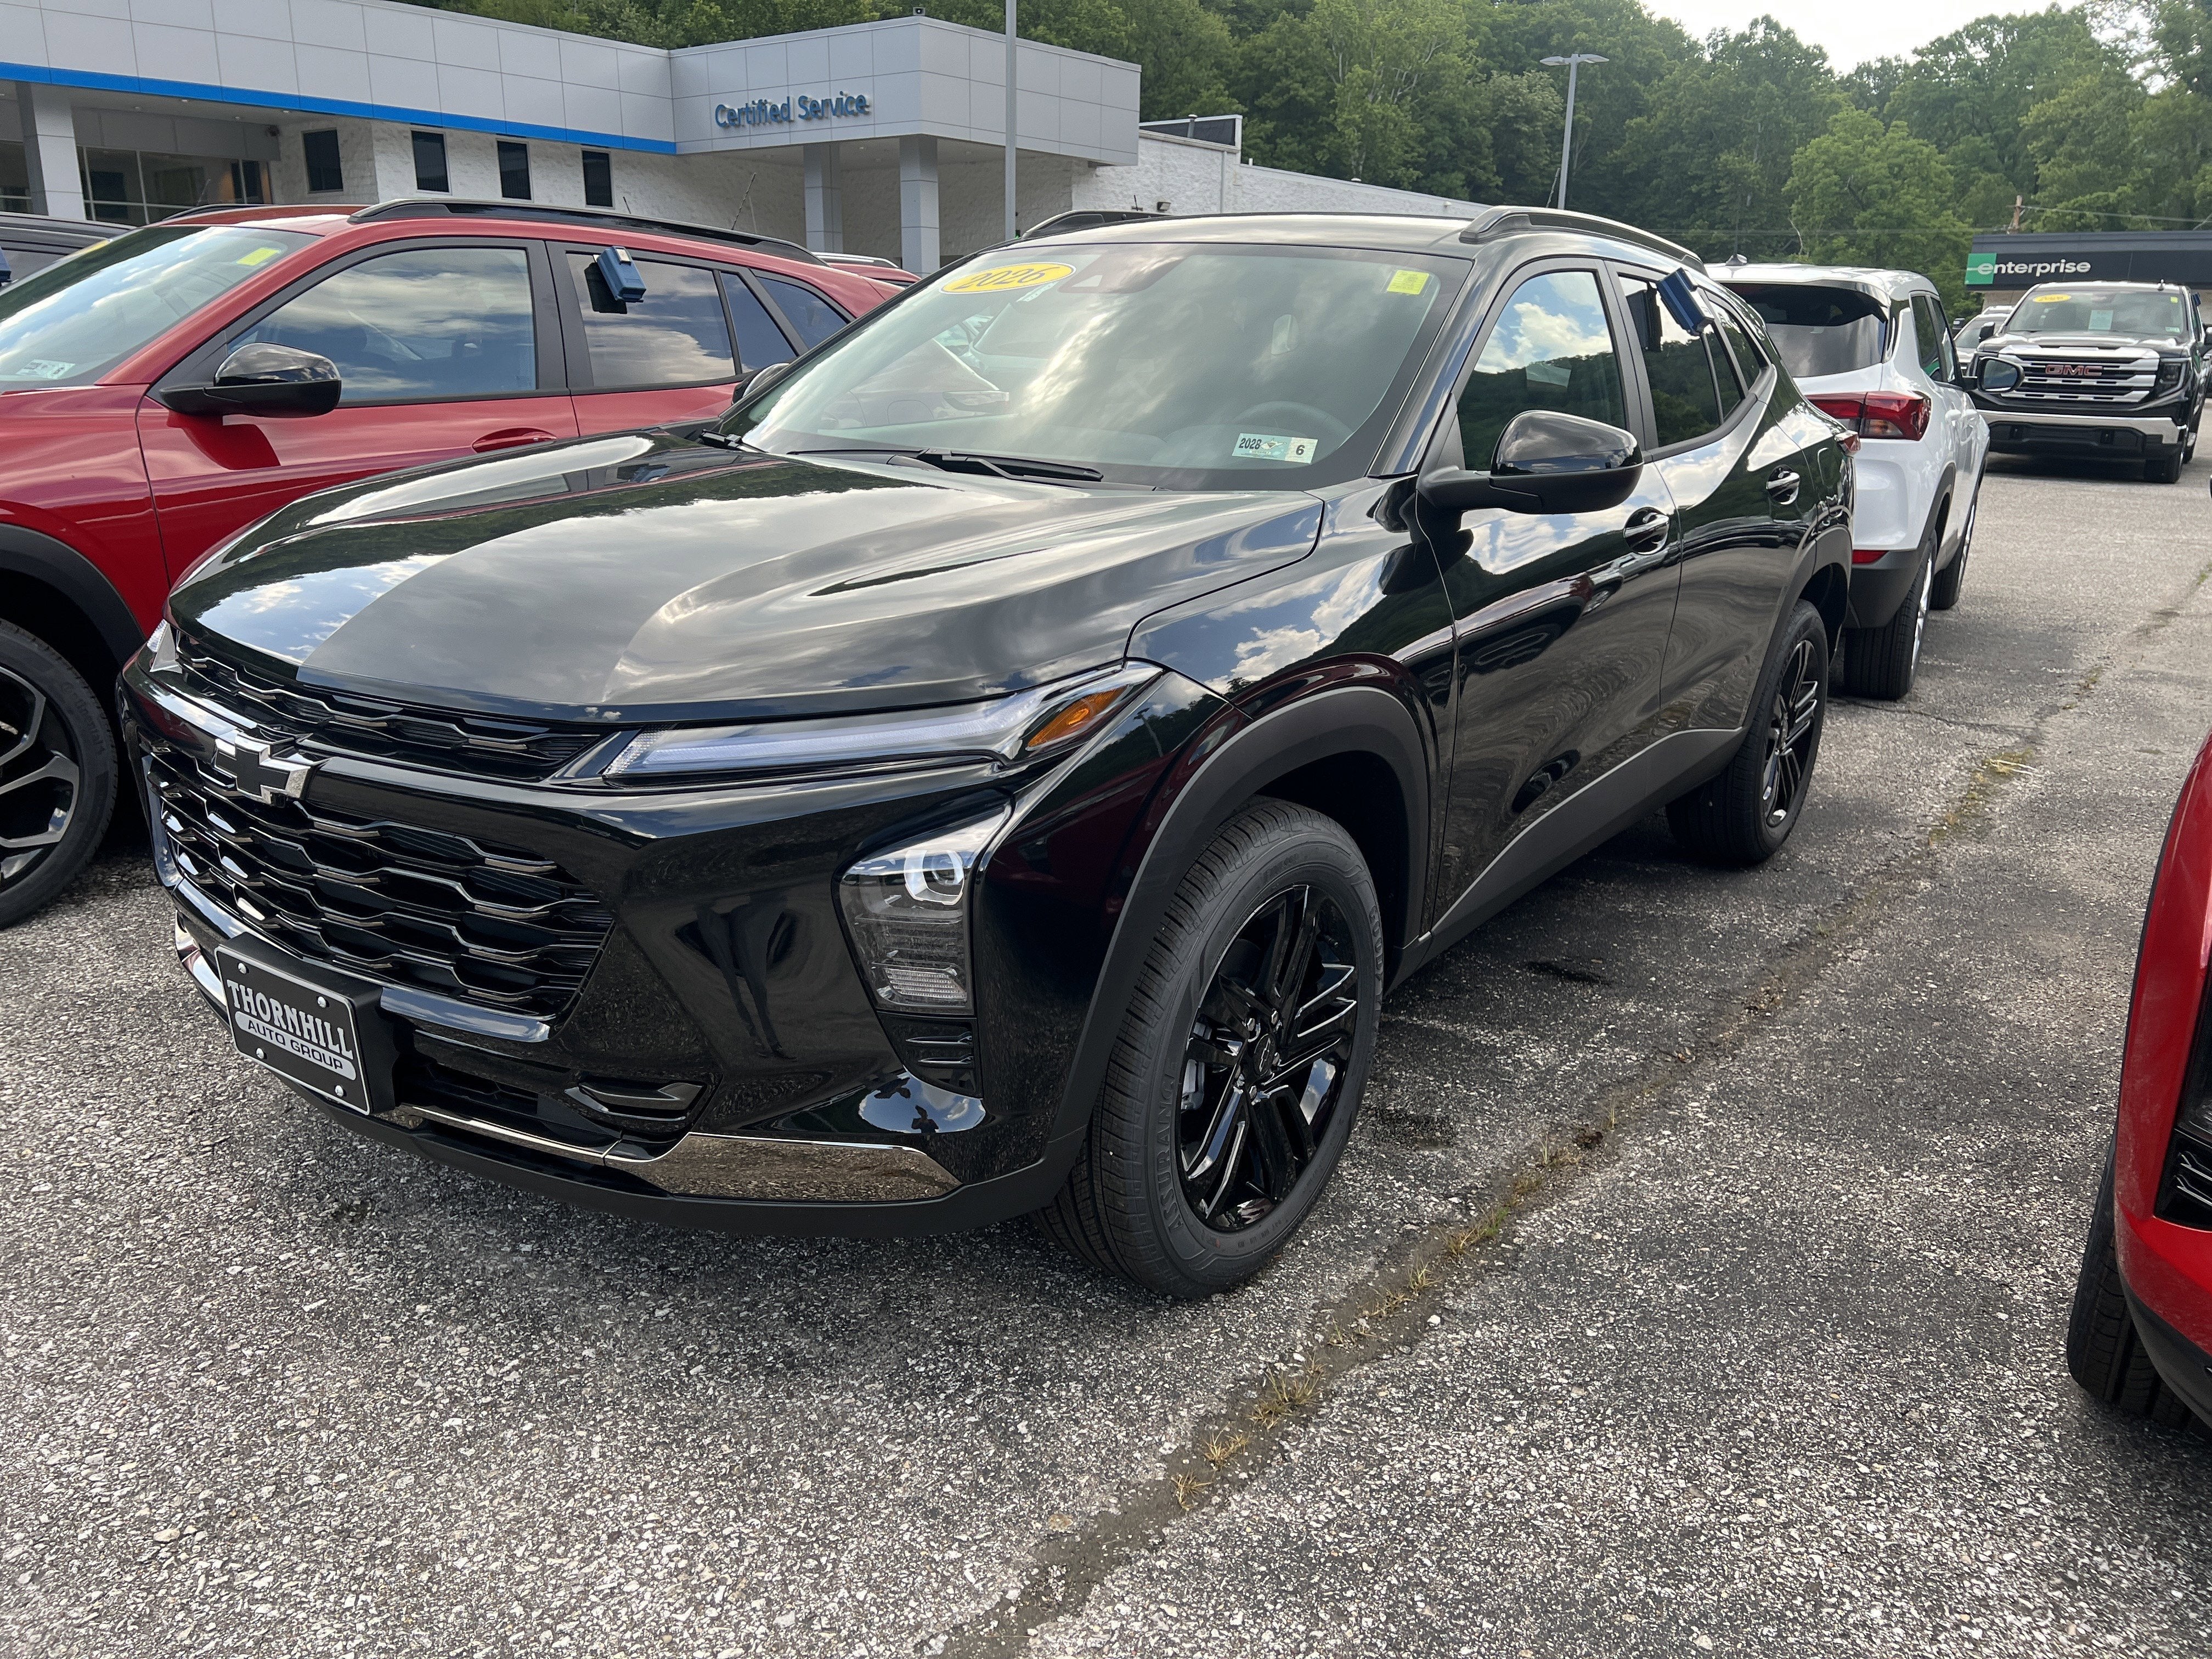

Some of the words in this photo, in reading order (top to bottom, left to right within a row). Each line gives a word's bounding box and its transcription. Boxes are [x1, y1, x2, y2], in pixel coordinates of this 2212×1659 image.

[715, 95, 791, 128] Certified
[798, 91, 870, 121] Service
[953, 267, 1060, 290] 2026
[1977, 258, 2091, 276] enterprise
[2045, 364, 2103, 377] GMC
[1238, 437, 1262, 450] 2028
[1296, 444, 1306, 456] 6
[227, 979, 354, 1060] THORNHILL
[248, 1019, 286, 1046] AUTO
[290, 1039, 343, 1070] GROUP
[1156, 1060, 1184, 1232] ASSURANCE
